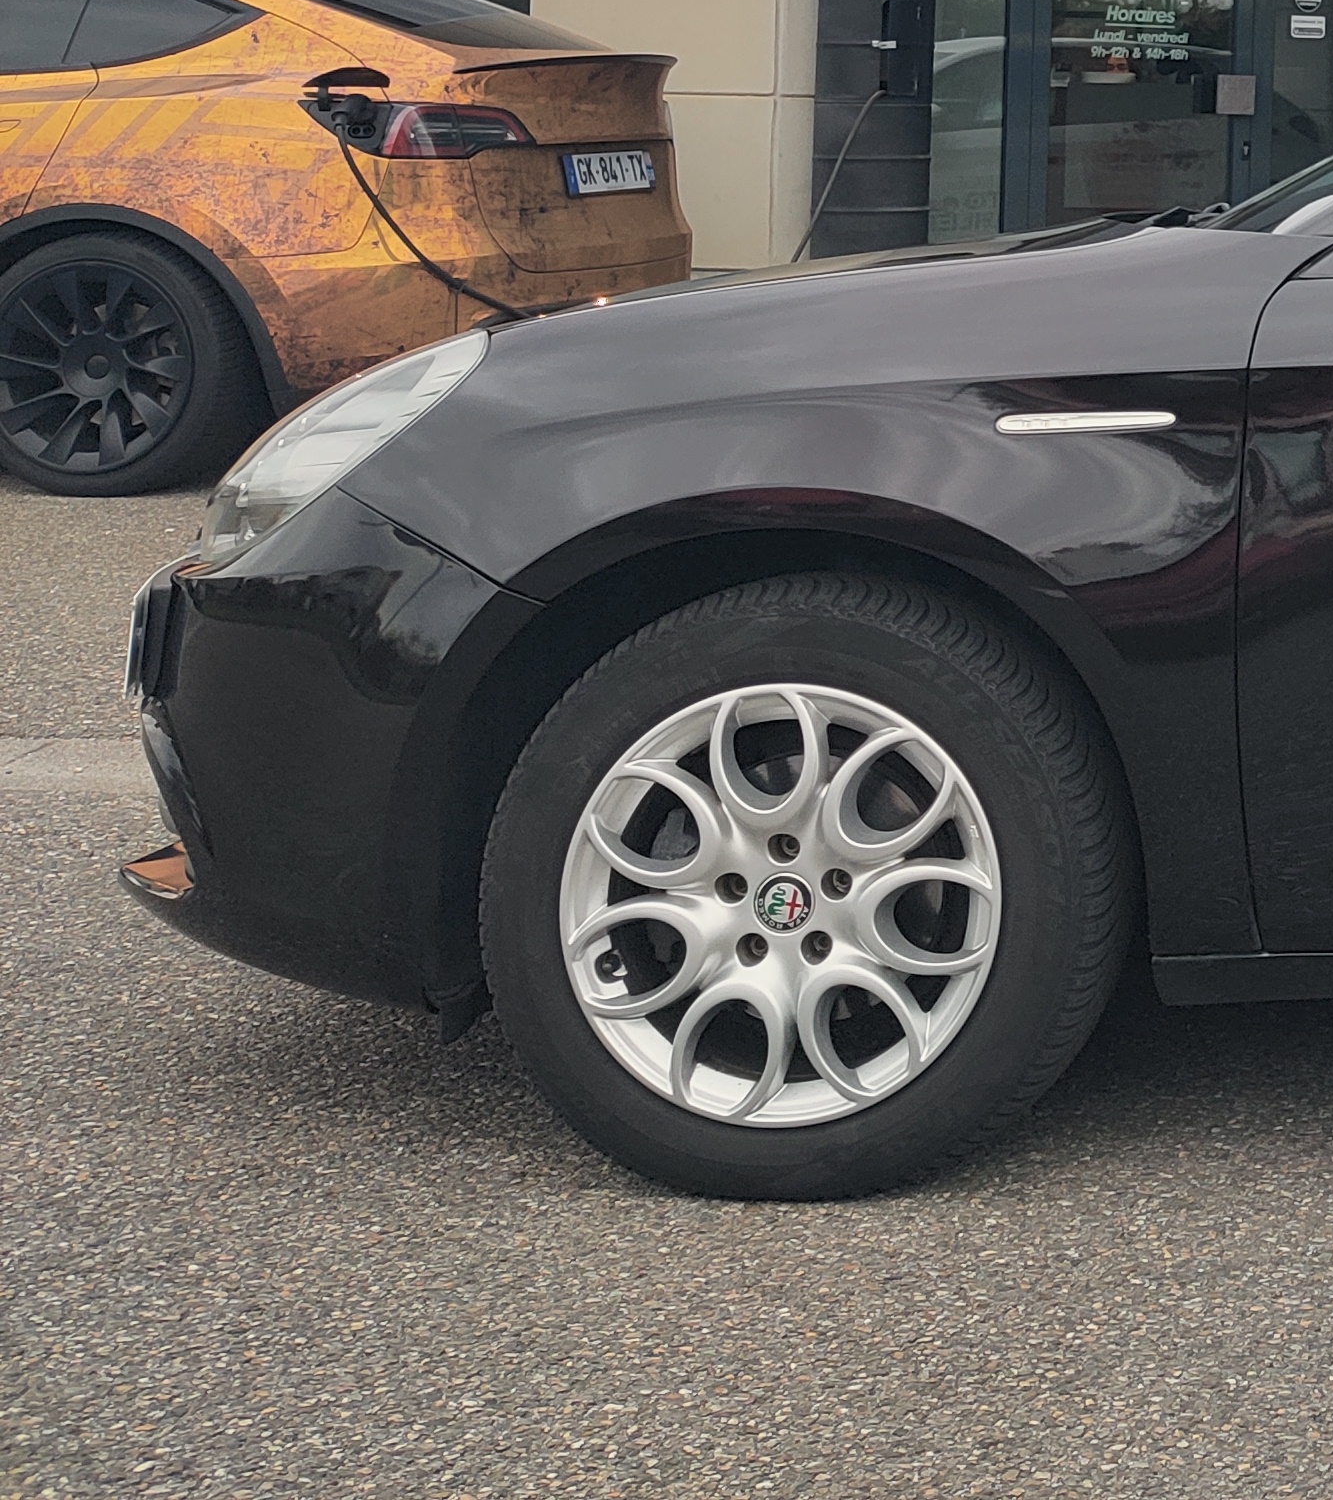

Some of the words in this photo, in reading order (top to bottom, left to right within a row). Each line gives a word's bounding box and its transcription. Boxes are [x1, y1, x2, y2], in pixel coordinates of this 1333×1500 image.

[1105, 5, 1176, 23] Horaires
[1137, 31, 1189, 44] vendredi
[577, 154, 647, 185] GK-841-TX
